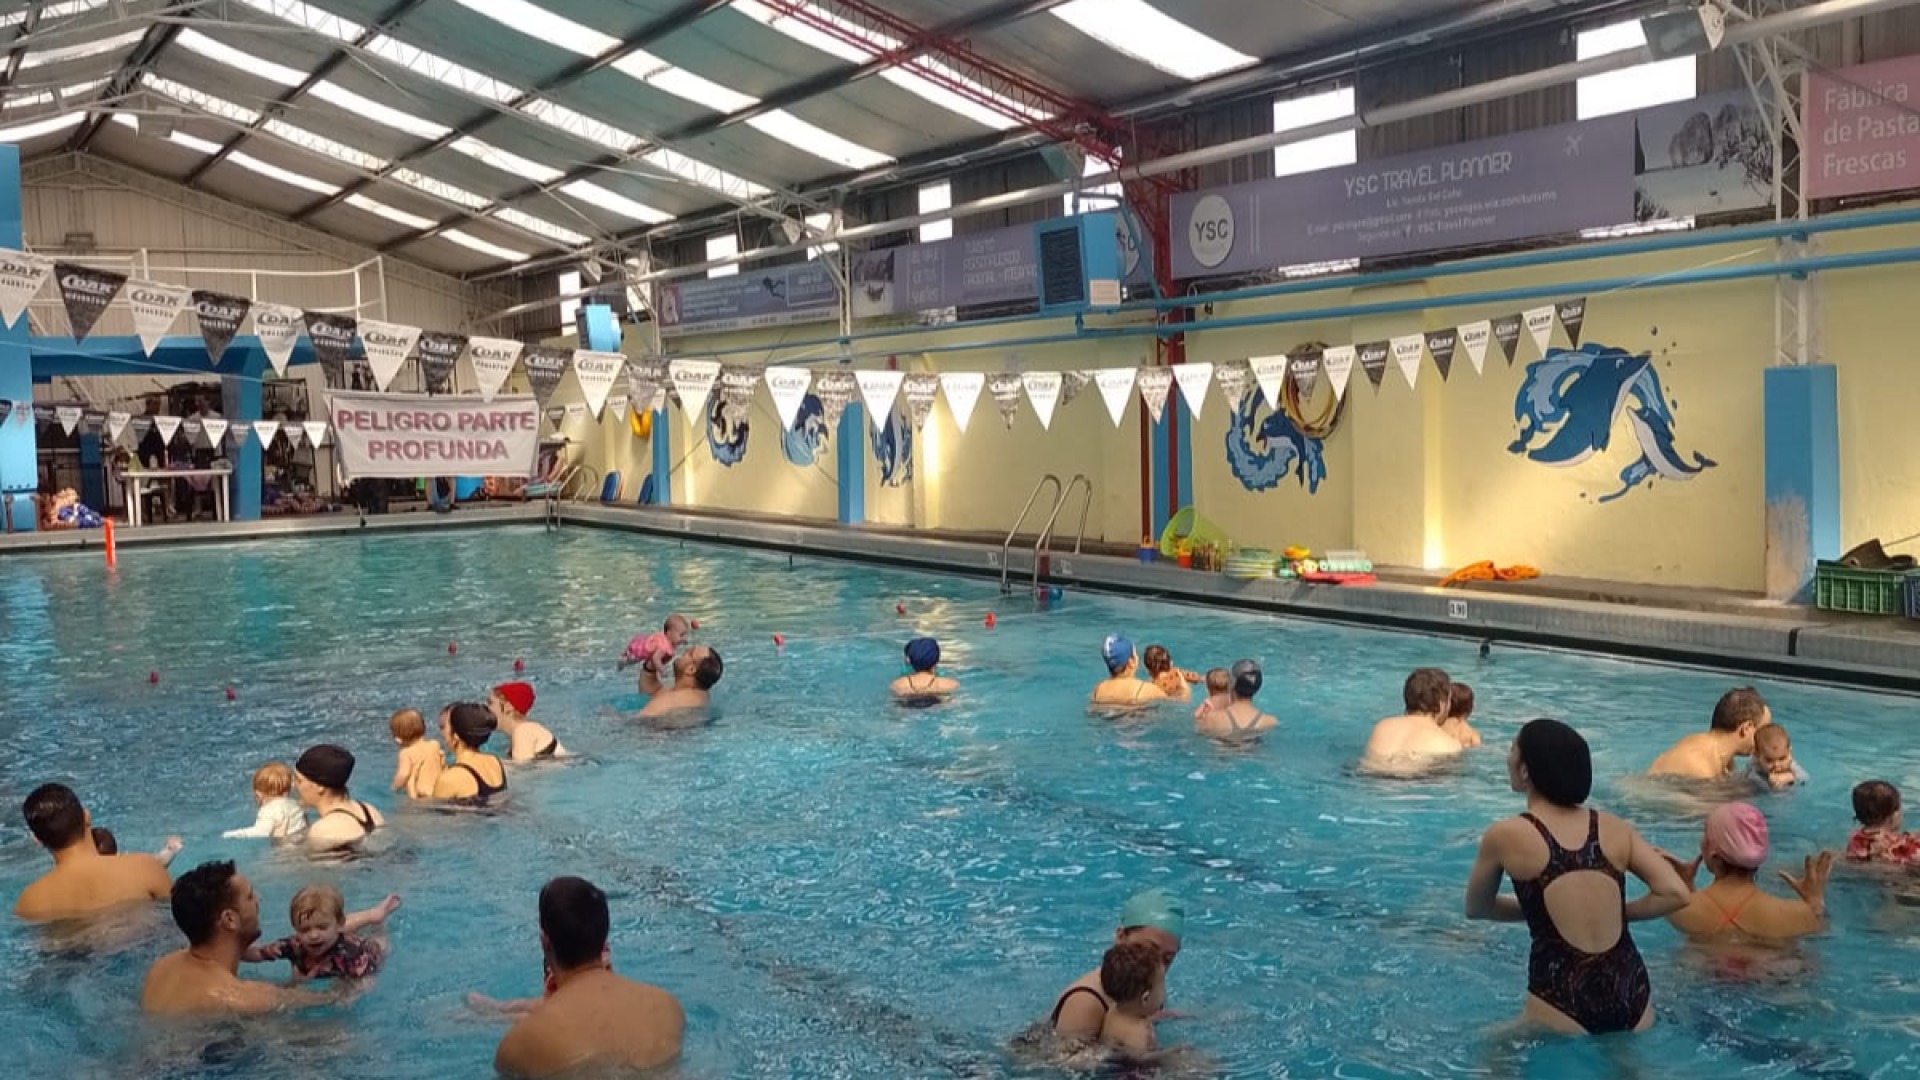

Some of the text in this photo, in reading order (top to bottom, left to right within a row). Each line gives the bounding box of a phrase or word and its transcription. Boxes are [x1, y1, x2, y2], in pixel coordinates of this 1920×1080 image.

[1825, 79, 1909, 113] Fábrica
[1824, 118, 1851, 146] de
[1823, 150, 1906, 177] Frescas
[1344, 174, 1378, 198] YSC
[1382, 165, 1438, 191] TRAVEL
[1195, 218, 1228, 242] YSC
[257, 311, 299, 327] COA
[337, 409, 536, 431] PELIGRO PARTE
[368, 440, 510, 461] PROFUNDA
